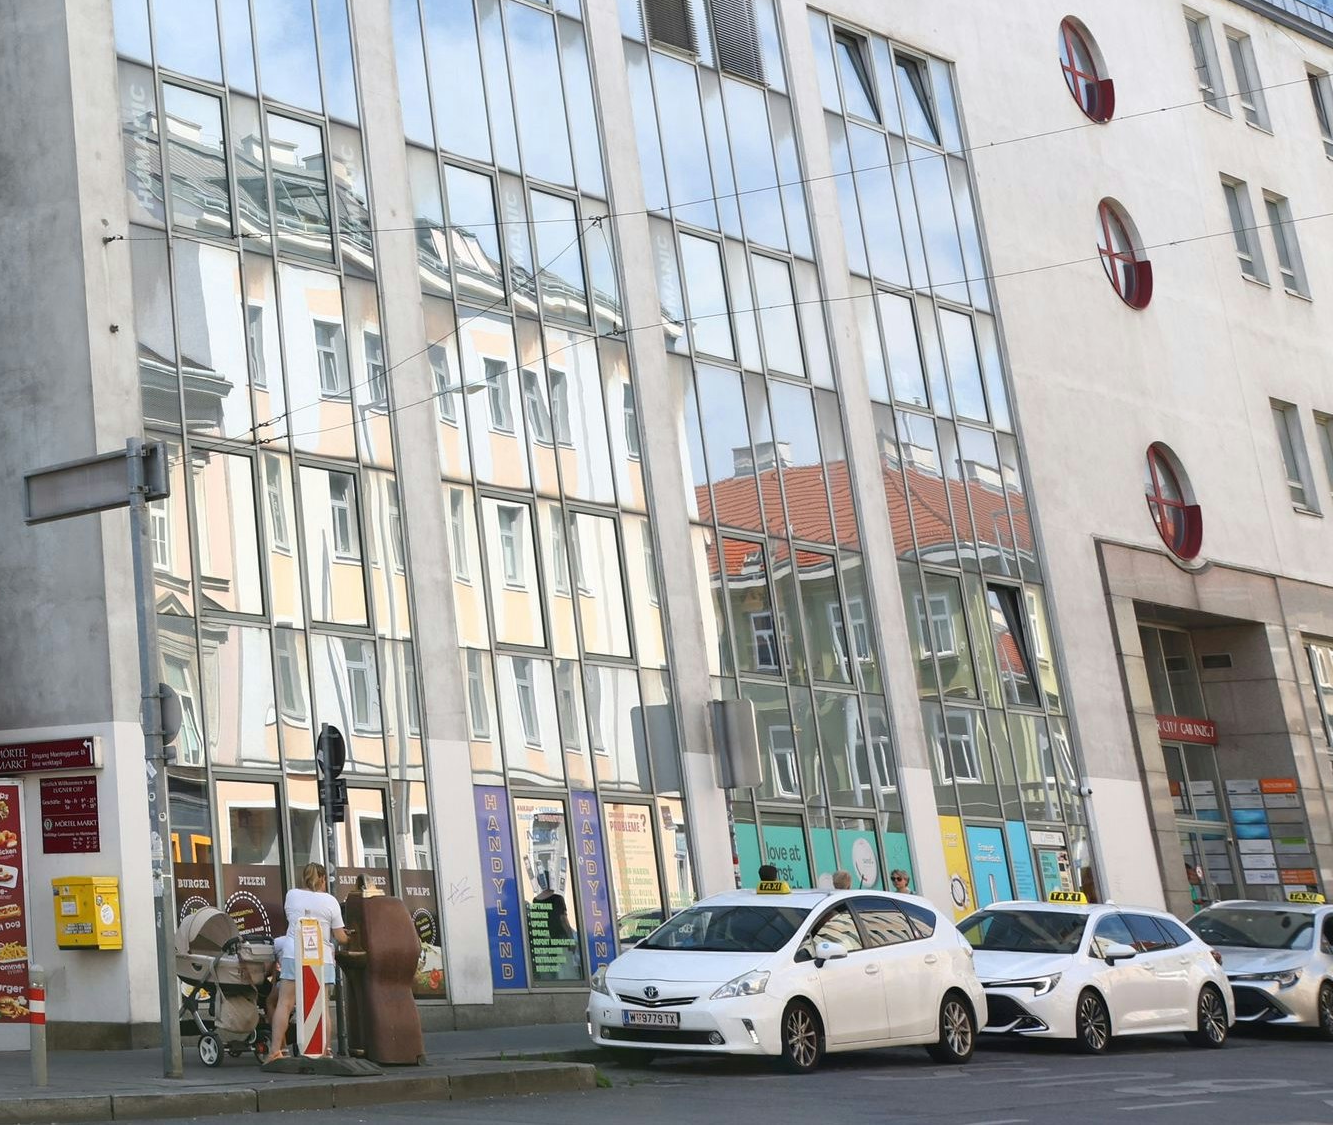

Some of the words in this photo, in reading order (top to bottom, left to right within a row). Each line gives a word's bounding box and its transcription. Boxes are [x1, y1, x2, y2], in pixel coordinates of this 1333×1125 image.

[765, 841, 787, 861] love
[790, 845, 802, 861] at
[177, 878, 210, 889] BURGER
[238, 876, 266, 886] PIZZEN
[405, 886, 431, 896] WRAPS
[484, 794, 515, 981] HANDYLAND
[760, 882, 782, 891] TAXI
[1052, 892, 1080, 901] TAXI
[1290, 892, 1318, 901] TAXI
[5, 920, 21, 929] Dog
[629, 1014, 636, 1024] W
[641, 1014, 663, 1025] 9779
[664, 1014, 675, 1025] TX
